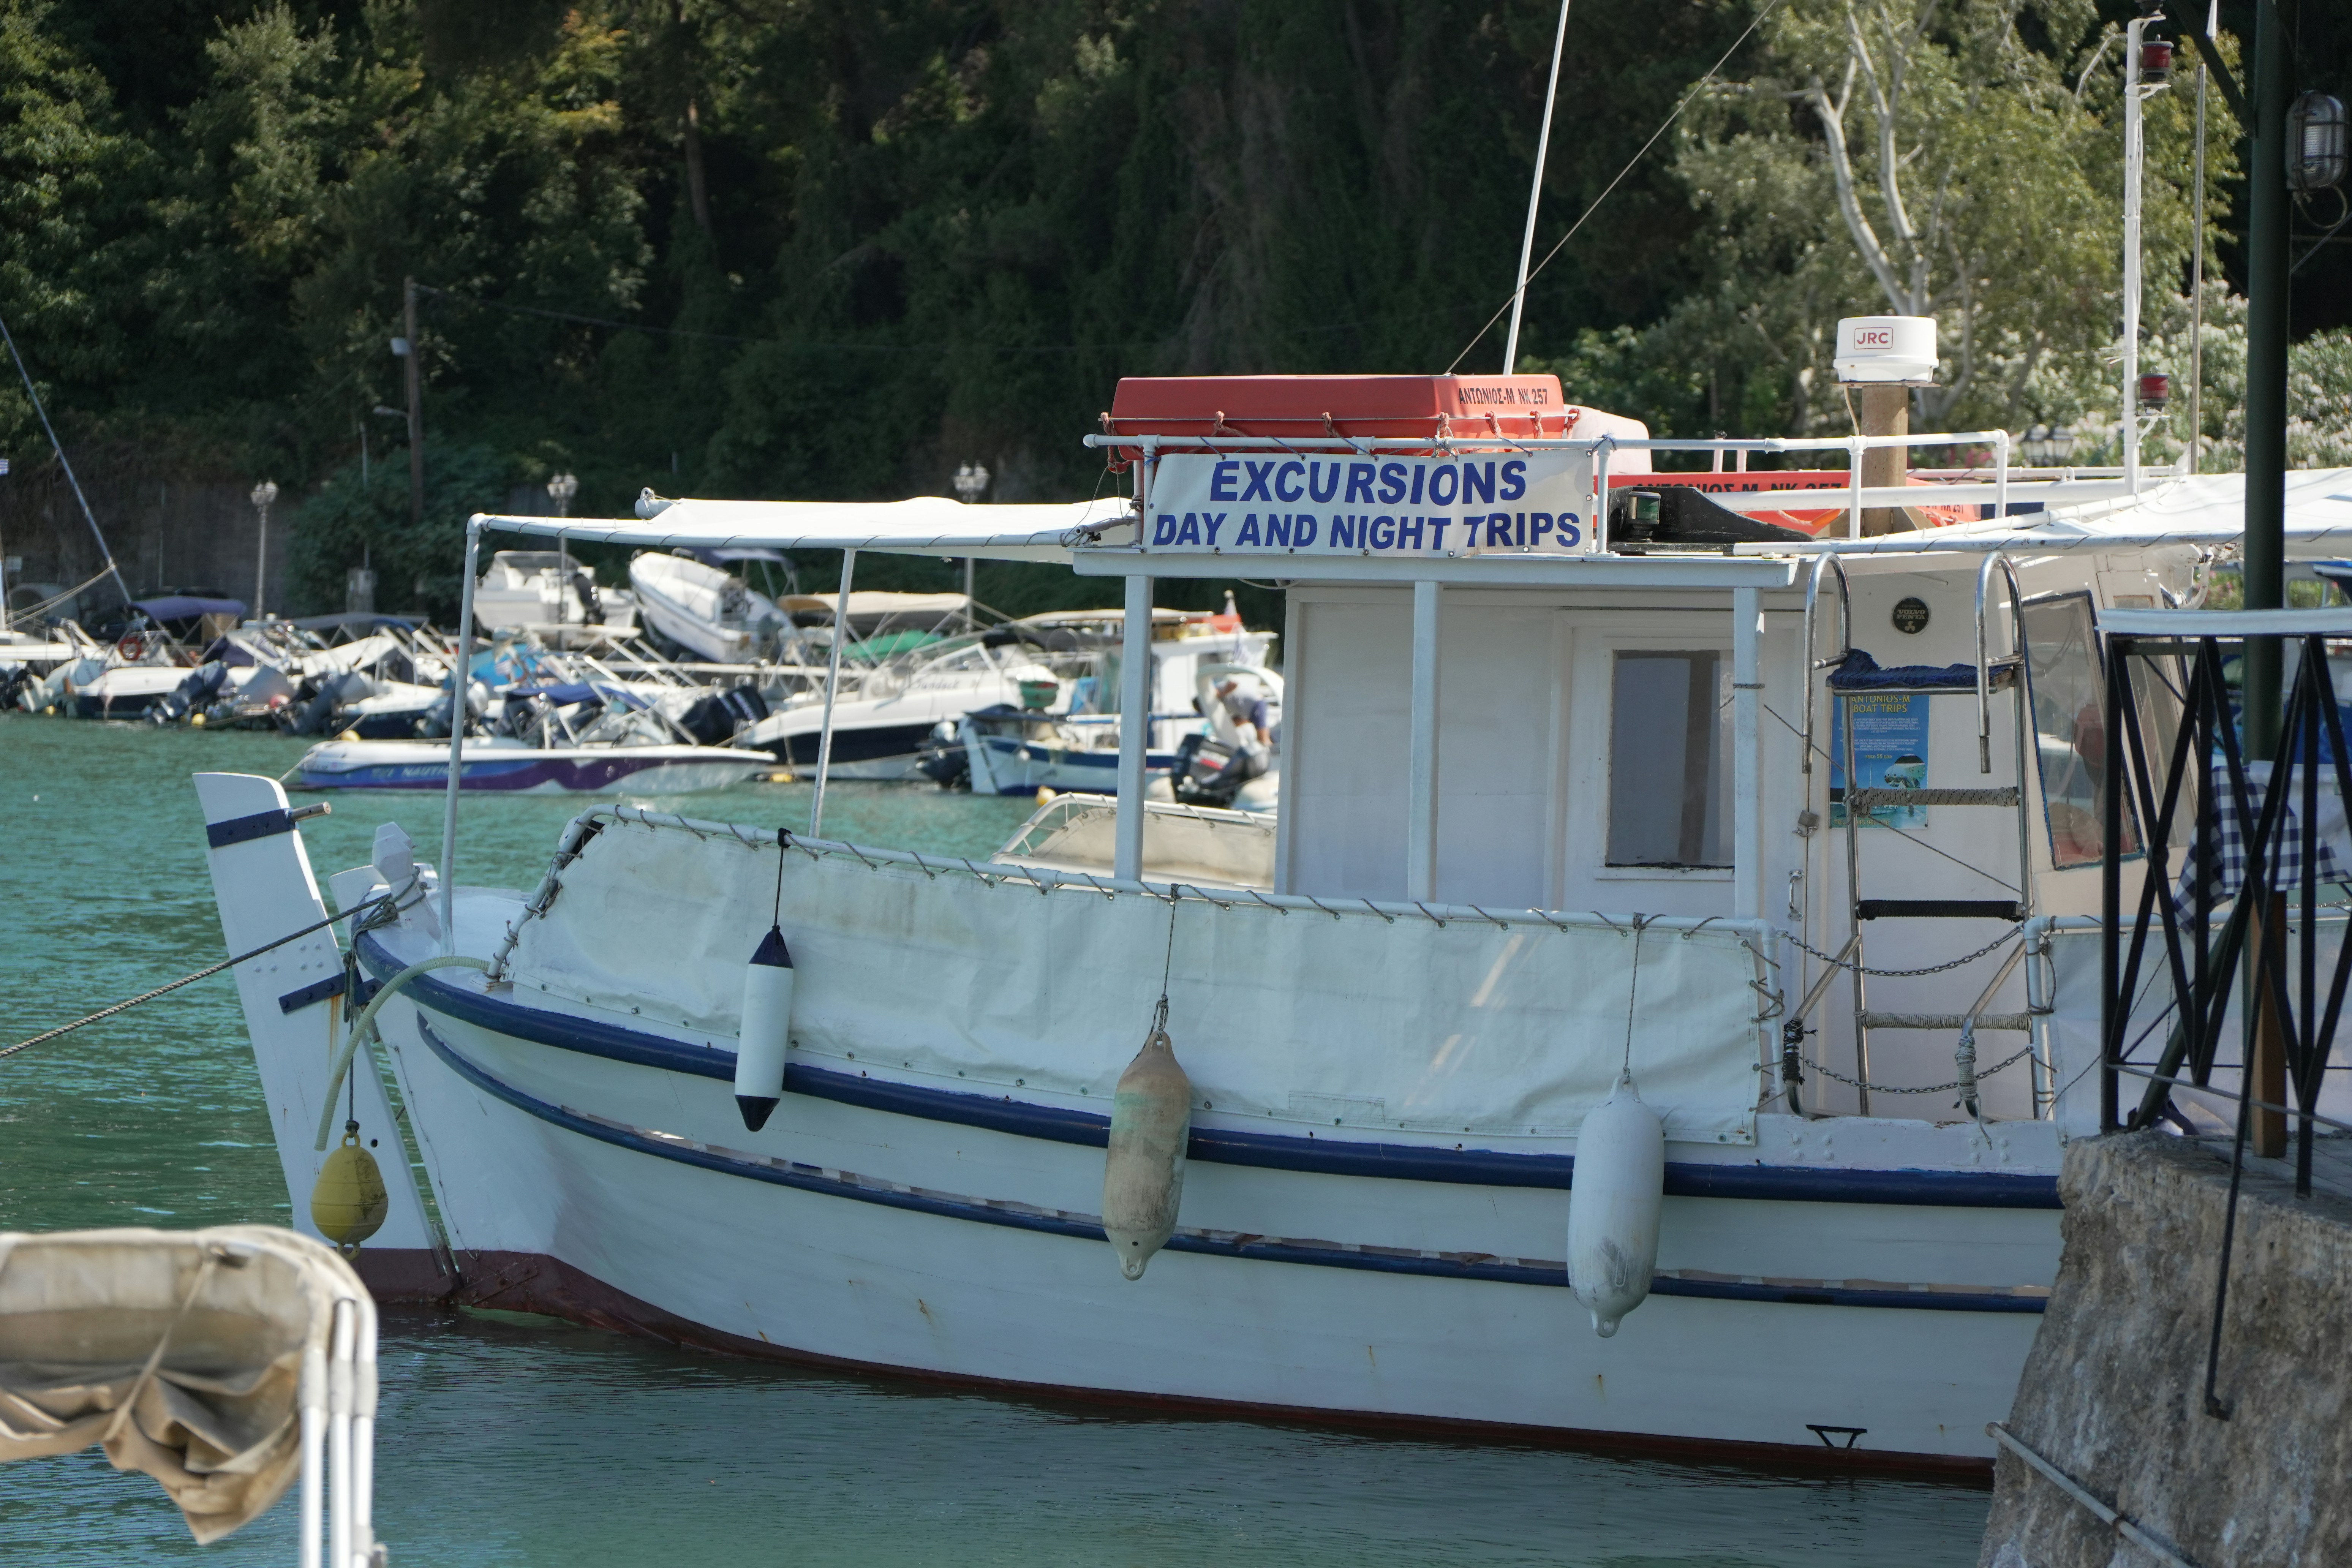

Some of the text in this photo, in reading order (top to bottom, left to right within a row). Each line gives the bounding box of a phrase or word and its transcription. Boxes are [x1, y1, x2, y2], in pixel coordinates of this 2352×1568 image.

[1857, 332, 1889, 344] JRC
[1532, 388, 1547, 405] 257
[1210, 460, 1527, 506] EXCURSIONS
[1152, 512, 1581, 550] DAY AND NIGHT TRIPS
[1853, 704, 1907, 713] BOAT TRIPS
